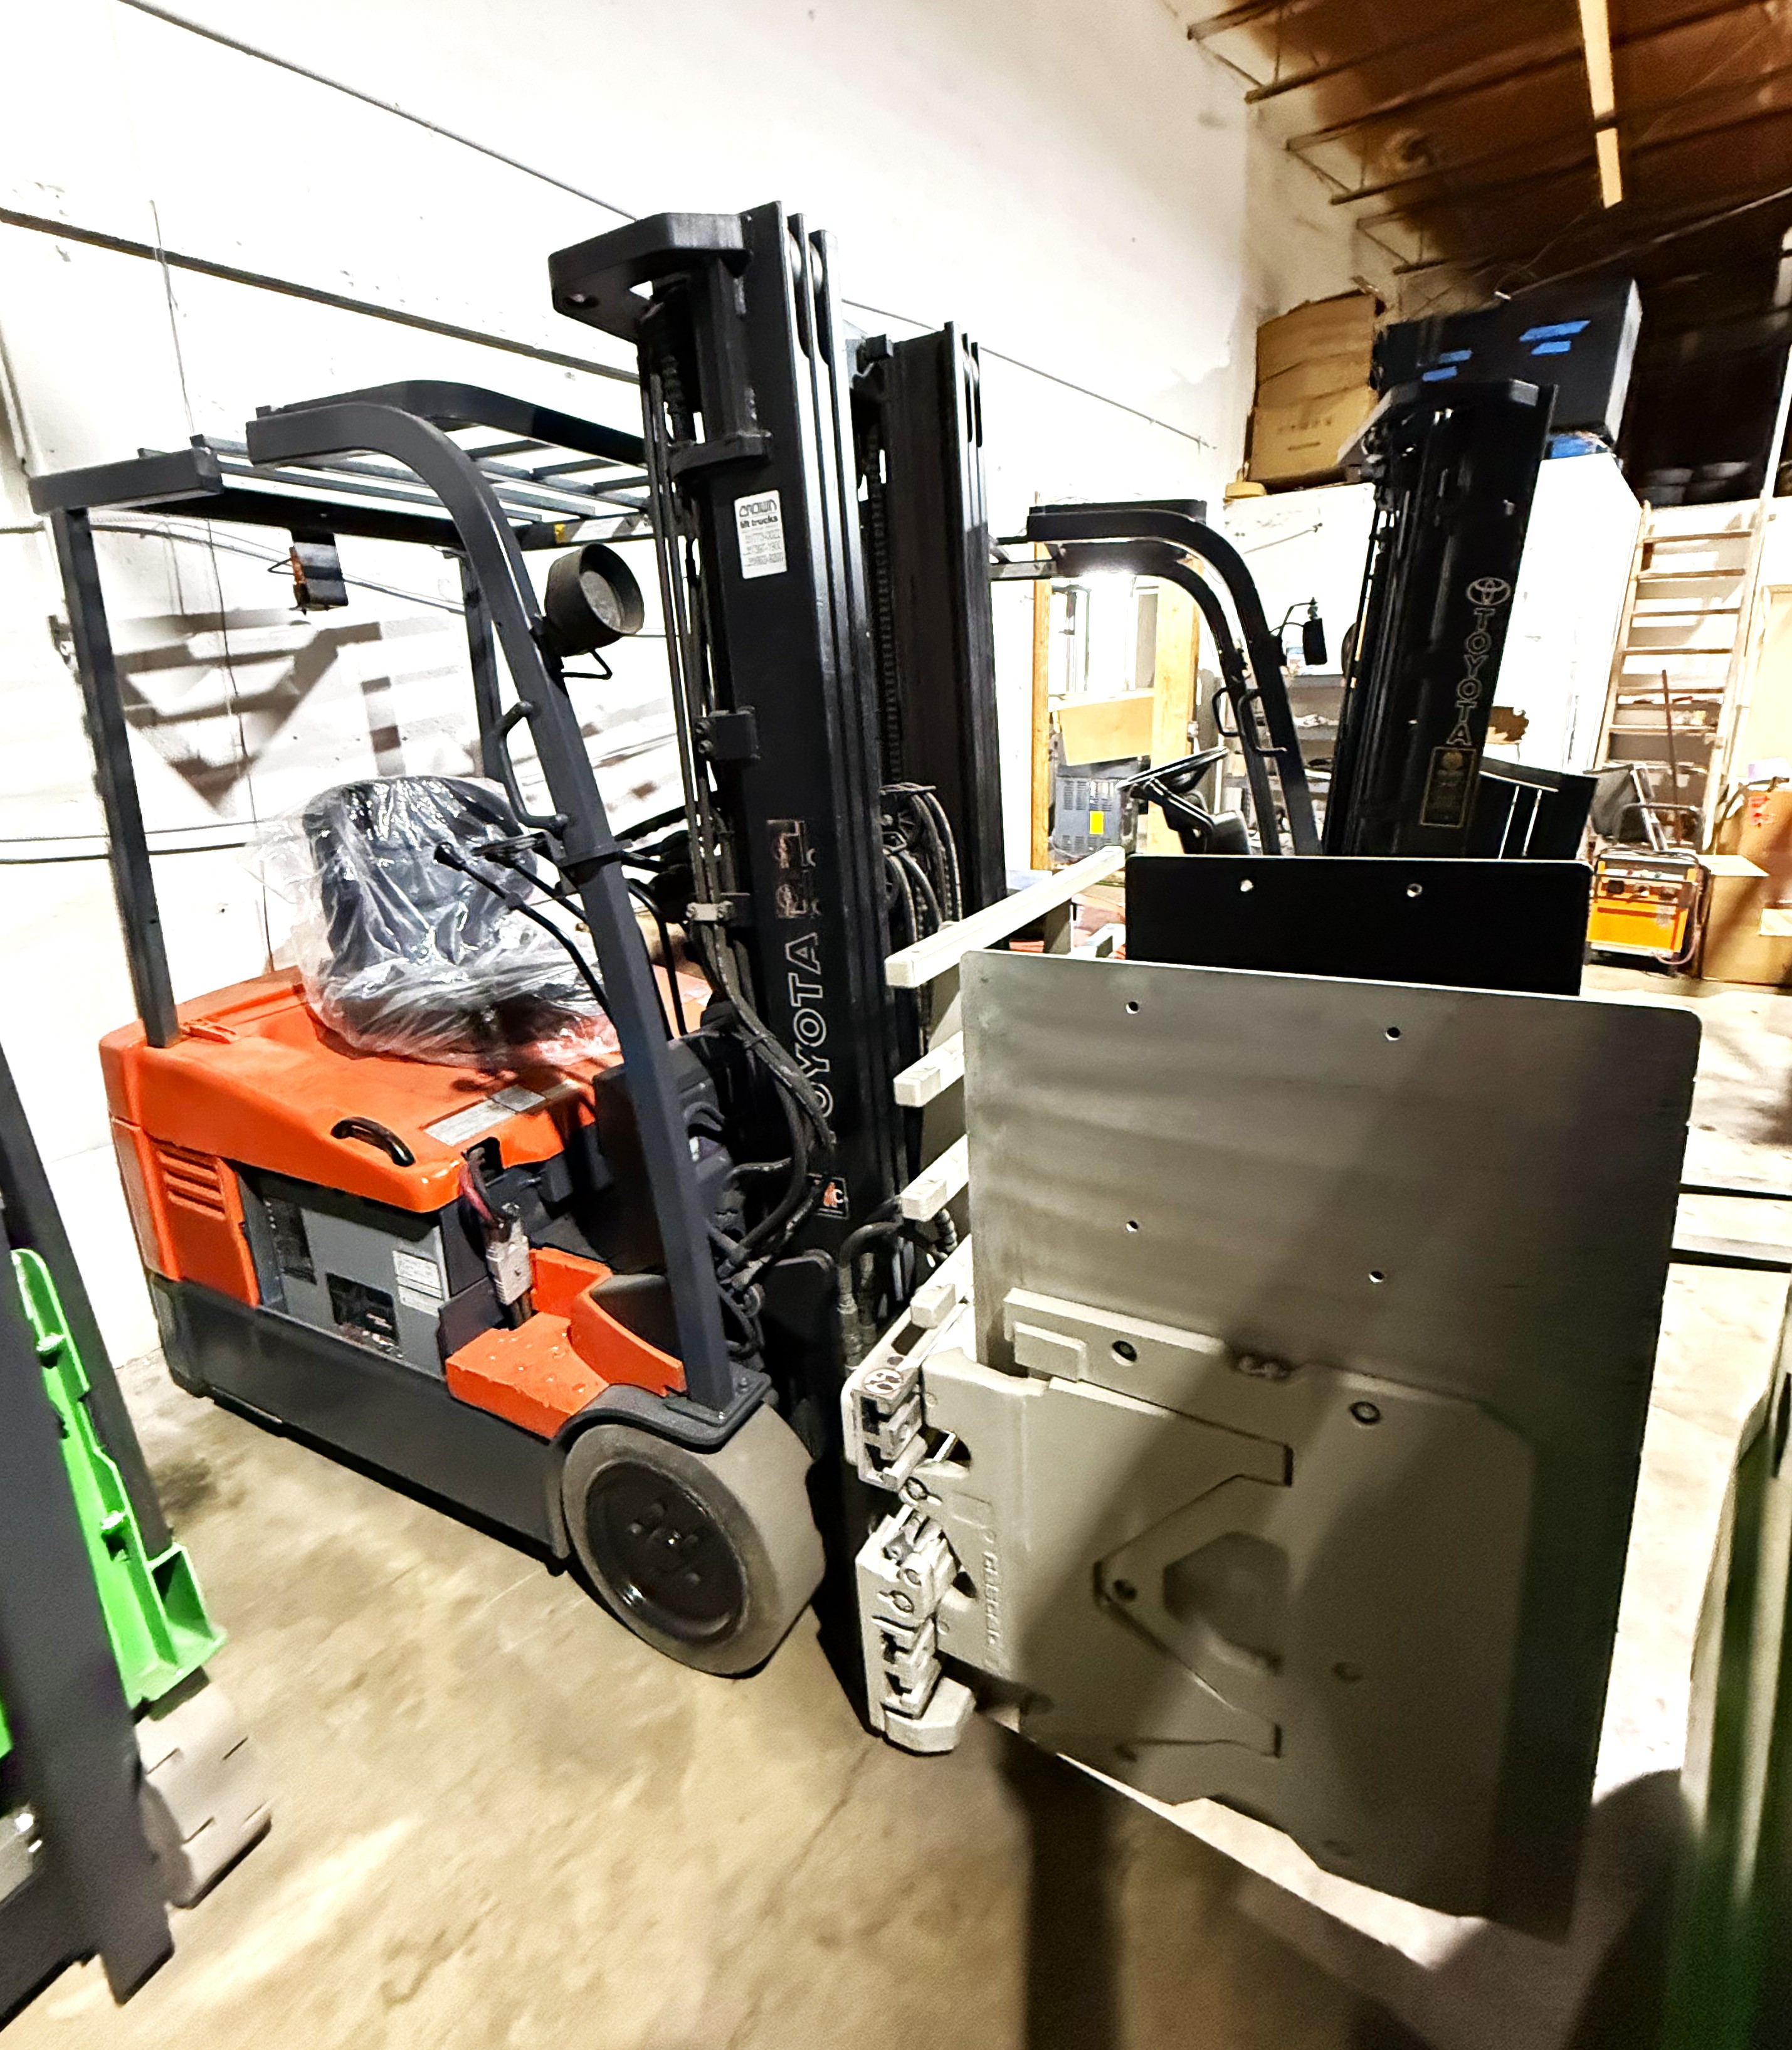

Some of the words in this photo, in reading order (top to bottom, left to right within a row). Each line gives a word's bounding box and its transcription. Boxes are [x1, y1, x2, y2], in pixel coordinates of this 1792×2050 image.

[751, 515, 778, 526] trucks
[1446, 607, 1496, 746] TOYOTA
[785, 931, 834, 1118] YOTA
